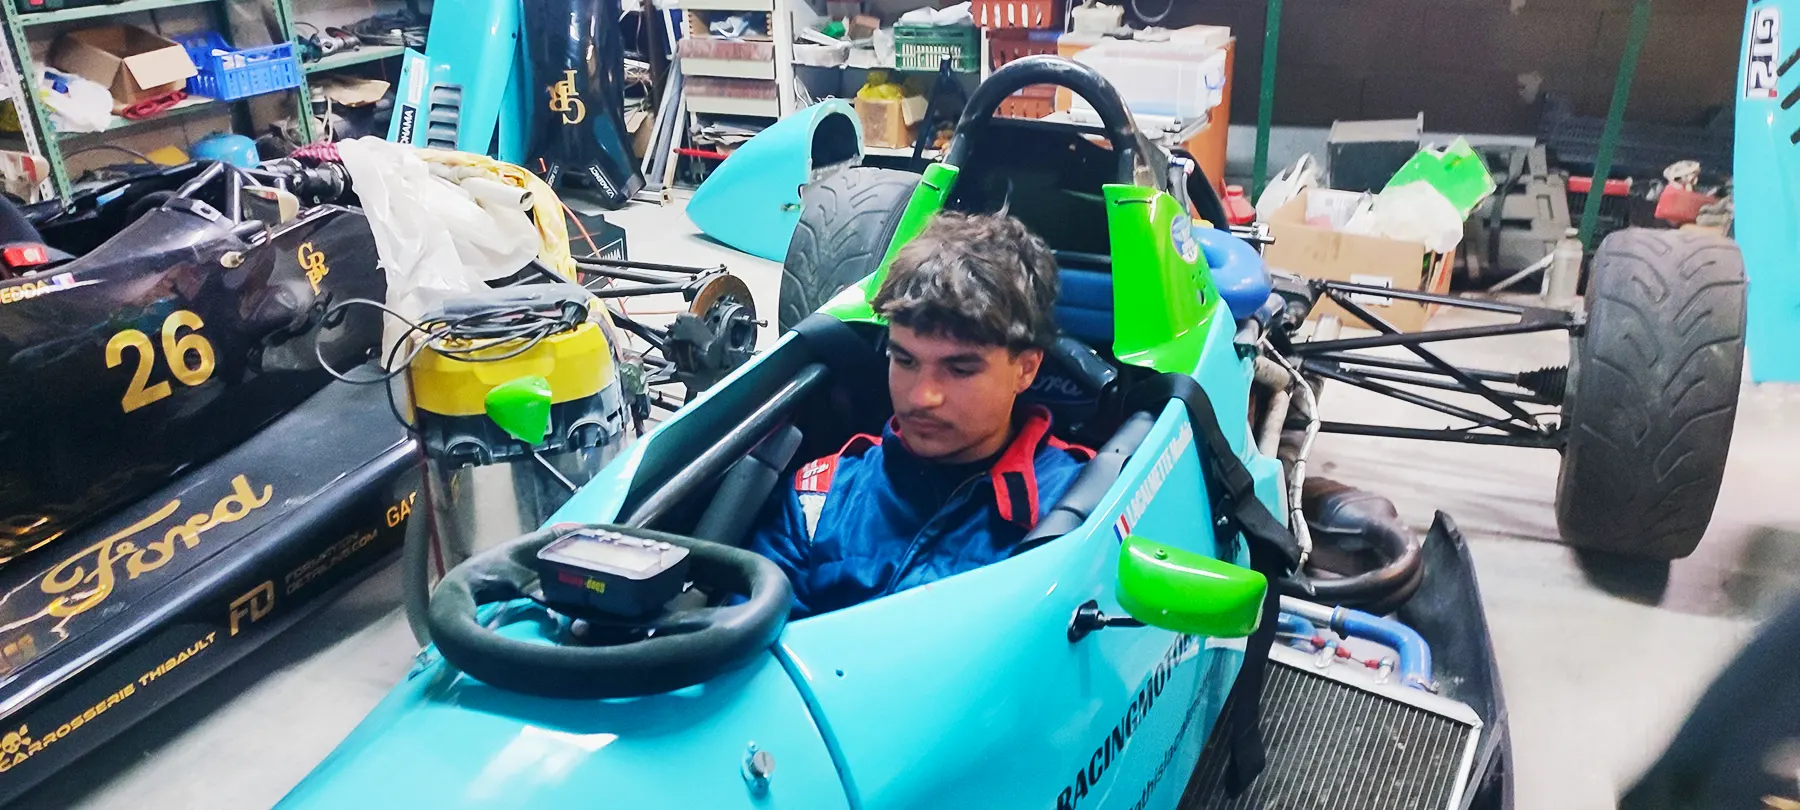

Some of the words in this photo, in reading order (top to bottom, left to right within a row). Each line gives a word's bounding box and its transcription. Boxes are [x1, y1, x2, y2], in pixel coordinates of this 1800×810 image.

[105, 309, 215, 413] 26
[41, 474, 272, 617] Ford
[0, 683, 136, 772] CARROSSERIE
[138, 631, 216, 686] THIBAULT
